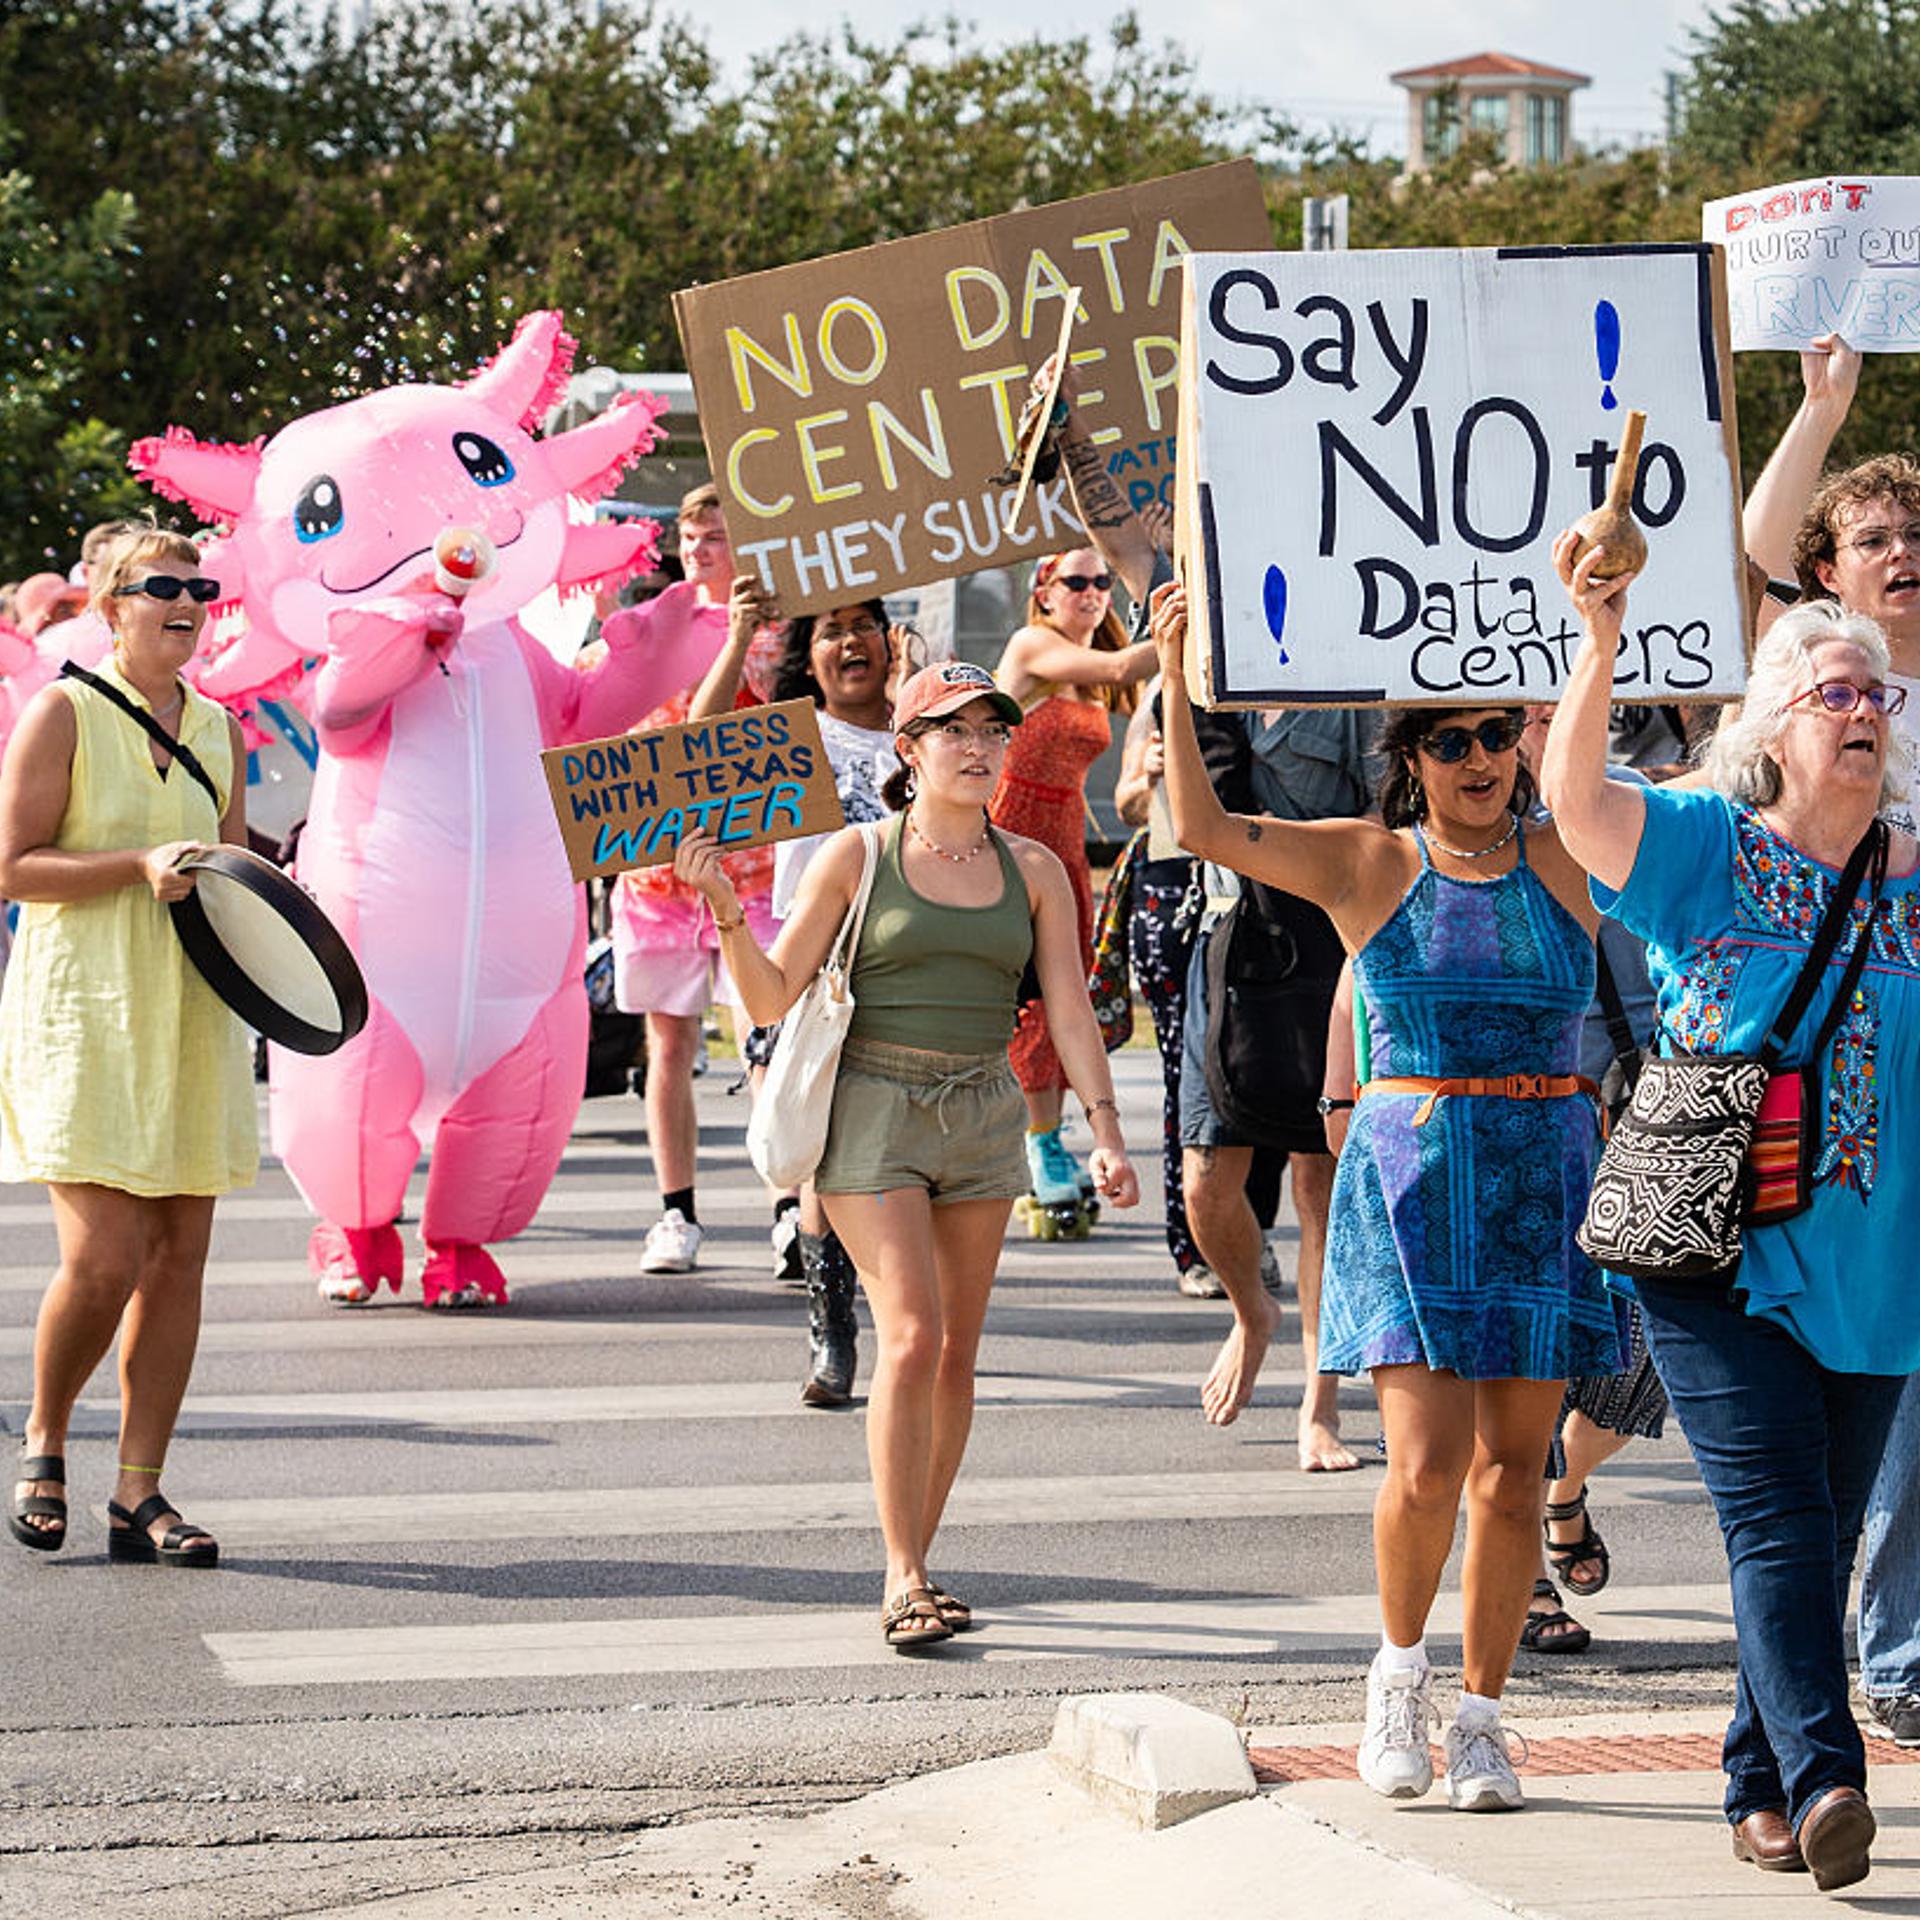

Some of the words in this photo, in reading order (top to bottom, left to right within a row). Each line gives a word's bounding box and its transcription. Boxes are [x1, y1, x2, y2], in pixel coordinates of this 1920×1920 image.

[1859, 226, 1920, 262] OU
[725, 297, 888, 413] NO
[944, 219, 1193, 352] DATA
[1205, 269, 1429, 427] Say
[1316, 397, 1551, 558] NO
[1575, 438, 1686, 528] to
[736, 513, 907, 598] THEY
[923, 479, 1086, 564] SUCK
[1354, 556, 1543, 640] Data
[562, 735, 665, 786] DON'T
[682, 713, 791, 762] MESS
[570, 779, 659, 822] WITH
[674, 745, 814, 798] TEXAS
[592, 781, 806, 865] WATER
